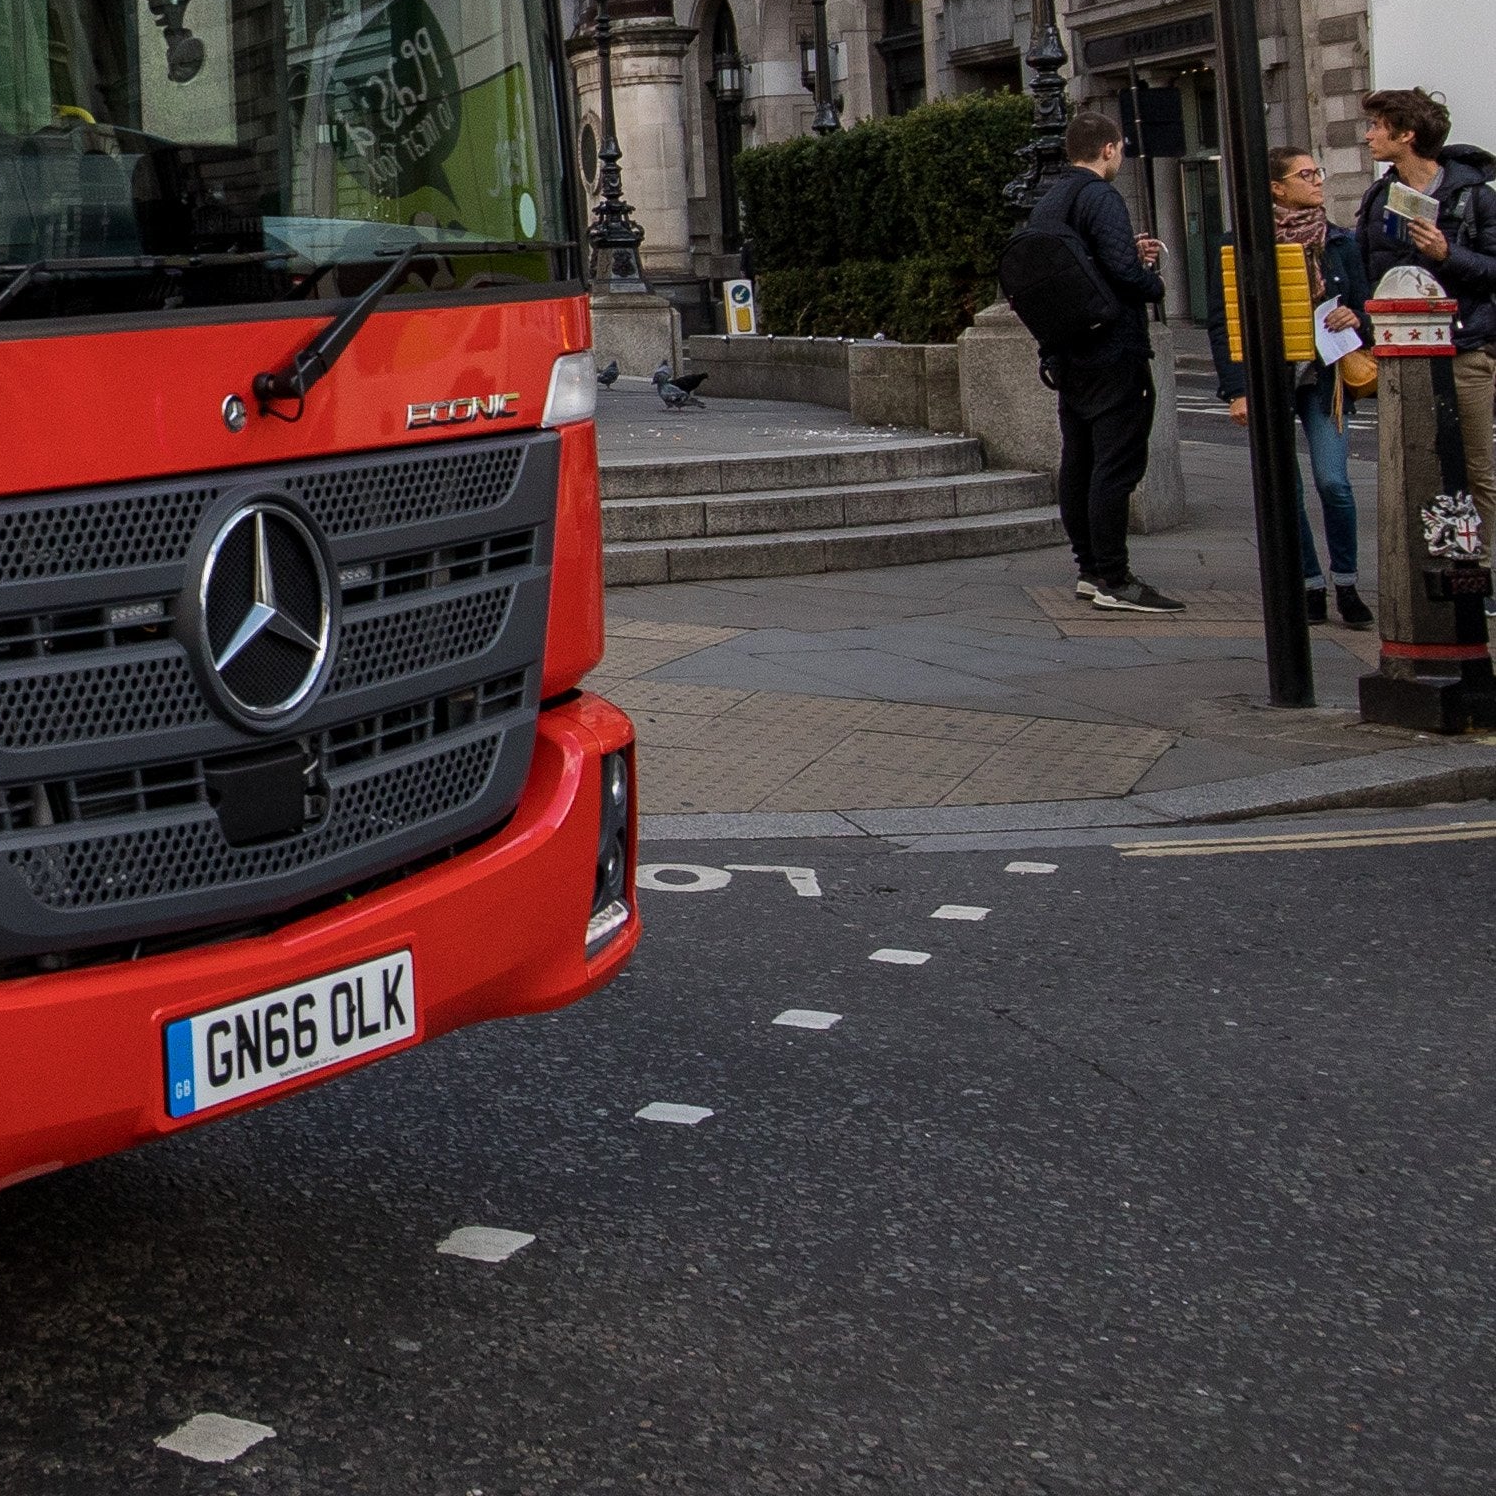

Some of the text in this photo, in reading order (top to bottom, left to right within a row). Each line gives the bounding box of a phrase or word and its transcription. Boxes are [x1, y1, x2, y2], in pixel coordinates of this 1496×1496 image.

[406, 393, 520, 430] ECONIC
[207, 964, 406, 1088] GN66 OLK
[175, 1078, 191, 1099] GB
